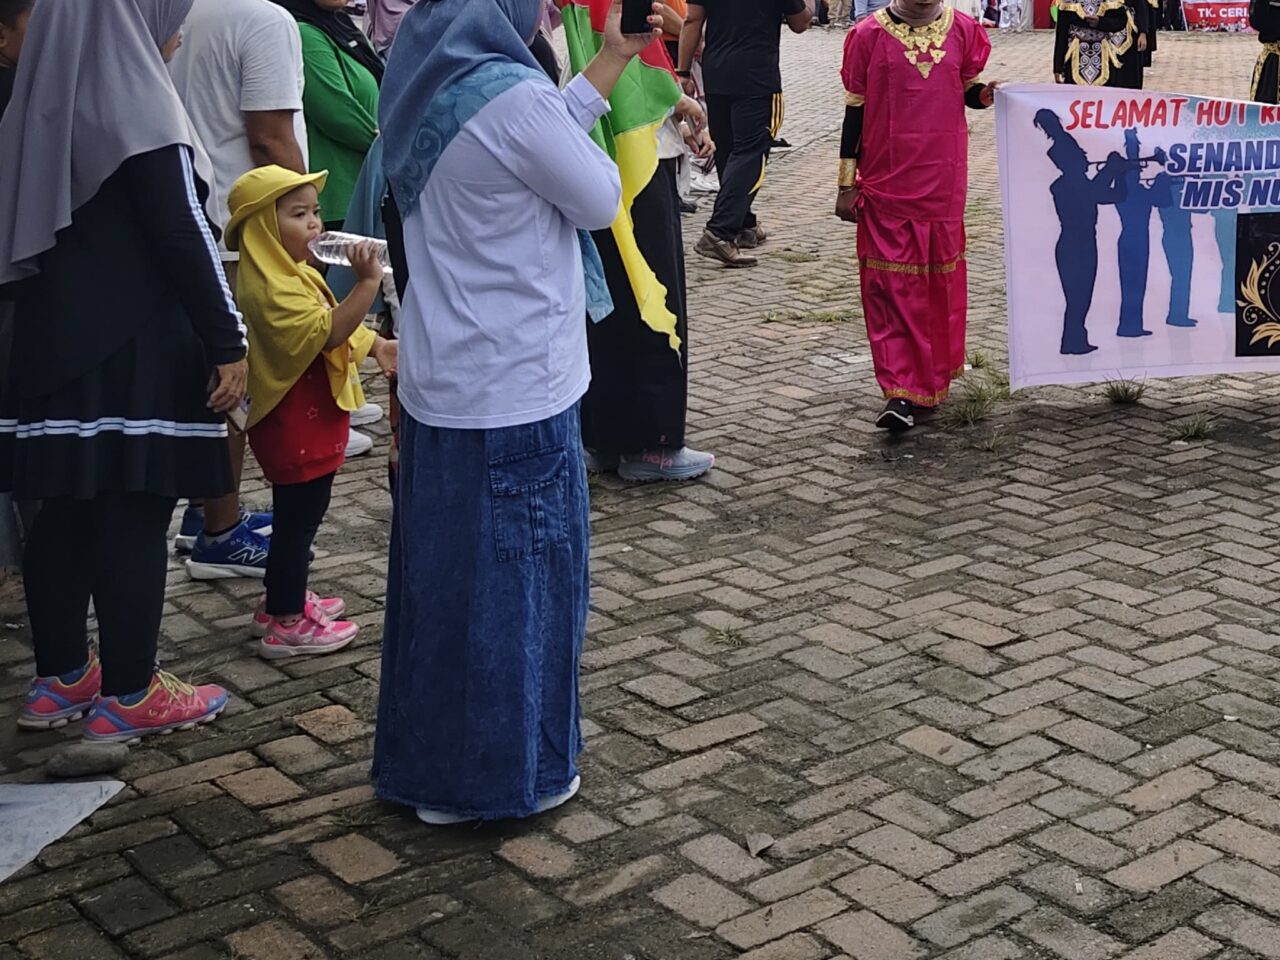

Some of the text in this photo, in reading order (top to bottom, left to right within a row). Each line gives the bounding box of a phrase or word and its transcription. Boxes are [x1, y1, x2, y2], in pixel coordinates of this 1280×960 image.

[1198, 7, 1250, 18] TK. CERI
[1066, 98, 1189, 131] SELAMAT
[1182, 180, 1243, 208] MIS
